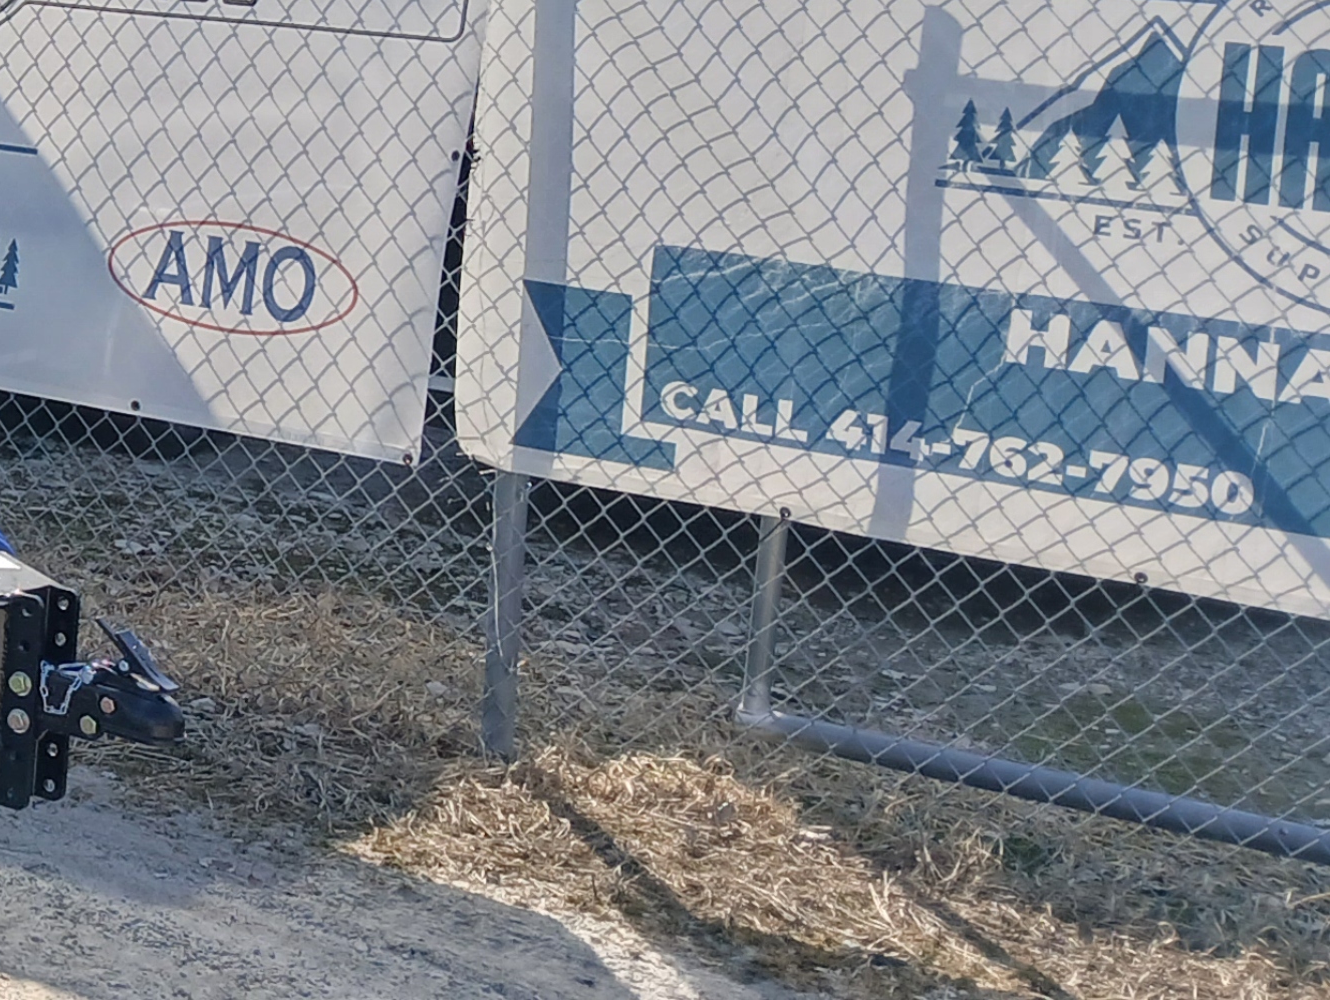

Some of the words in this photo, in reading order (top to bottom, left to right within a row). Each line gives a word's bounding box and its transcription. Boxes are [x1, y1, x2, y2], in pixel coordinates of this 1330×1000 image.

[142, 229, 317, 323] AMO
[660, 380, 808, 443] CALL
[826, 409, 1255, 515] 414-762-7950
